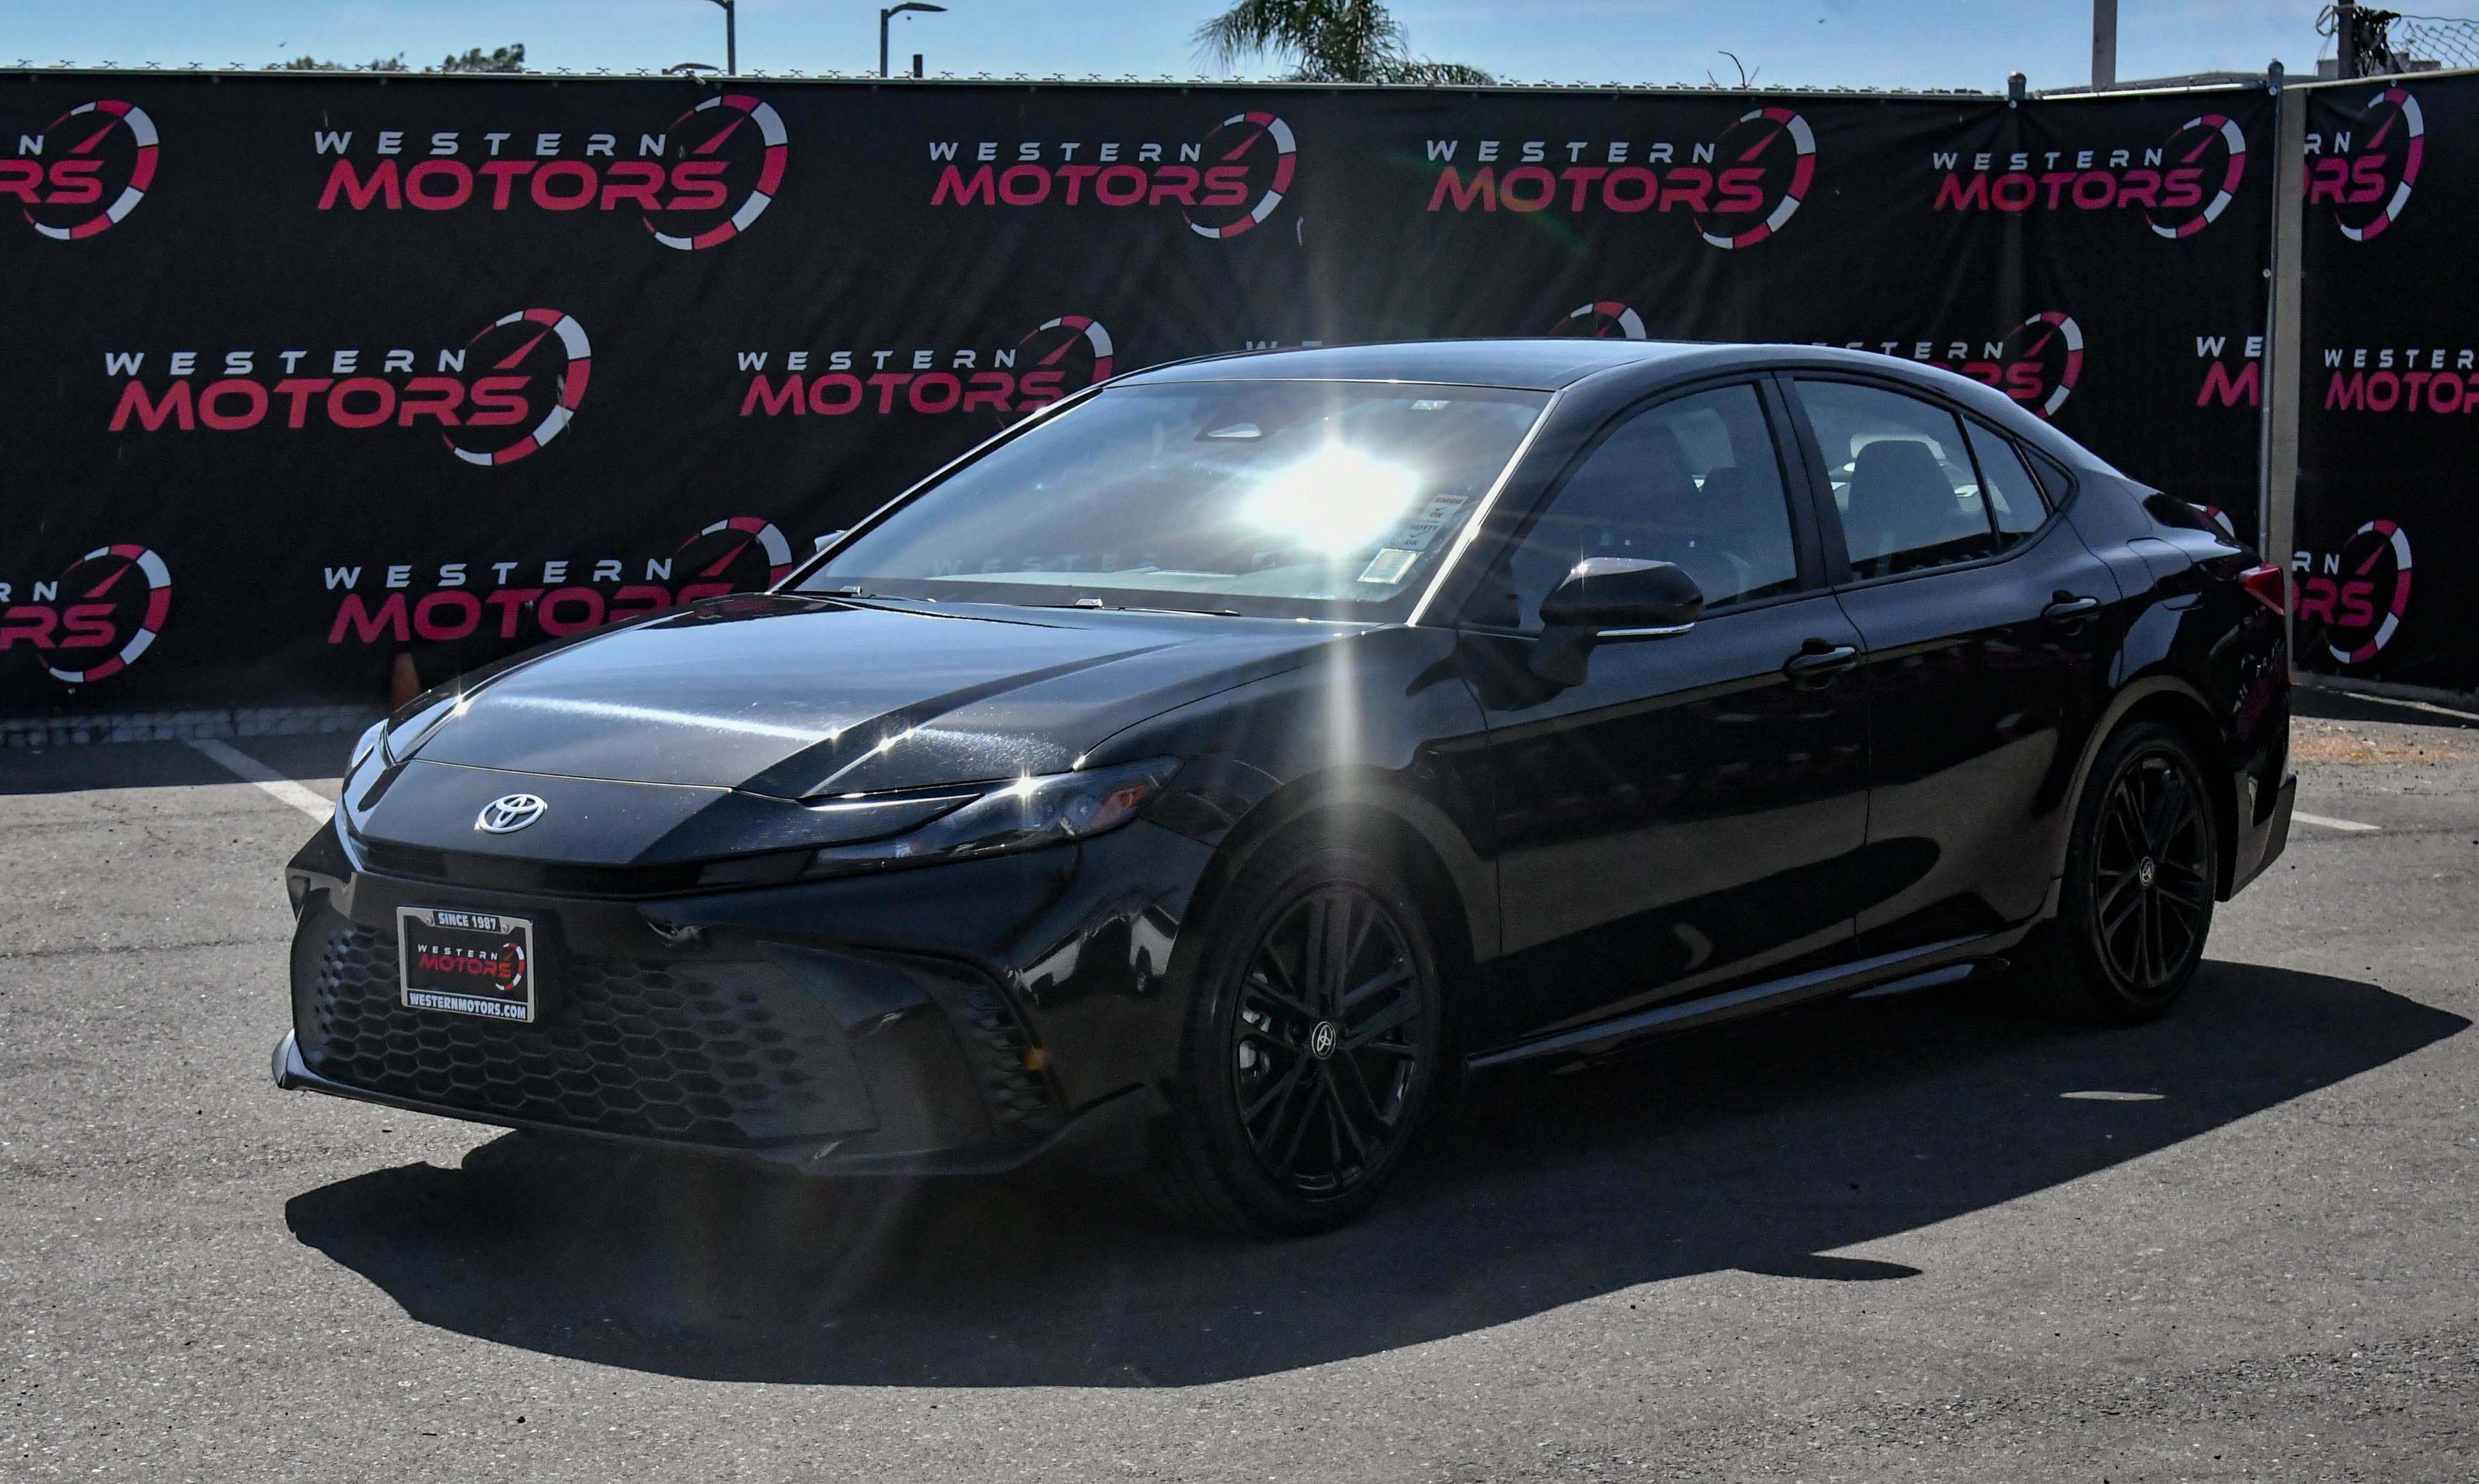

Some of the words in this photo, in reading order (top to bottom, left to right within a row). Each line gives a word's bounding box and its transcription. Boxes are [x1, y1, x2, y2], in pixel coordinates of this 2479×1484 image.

[315, 131, 666, 156] WESTERN
[929, 142, 1201, 162] WESTERN
[1427, 140, 1715, 163] WESTERN
[1933, 148, 2162, 170] WESTERN
[317, 160, 728, 210] MOTORS
[930, 164, 1250, 205] MOTORS
[1427, 166, 1765, 212] MOTORS
[1933, 169, 2203, 211] MOTORS
[105, 349, 466, 376] WESTERN
[738, 349, 1016, 371] WESTERN
[109, 375, 531, 432] MOTORS
[740, 372, 1066, 416] MOTORS
[1433, 497, 1463, 505] SMOG
[1408, 523, 1440, 532] SAFETY
[324, 558, 672, 590] WESTERN
[438, 913, 468, 927] SINCE
[472, 916, 497, 930] 1987
[418, 944, 498, 961] WESTERN
[420, 954, 512, 979] MOTORS
[410, 992, 526, 1019] WESTERNMOTORS.COM
